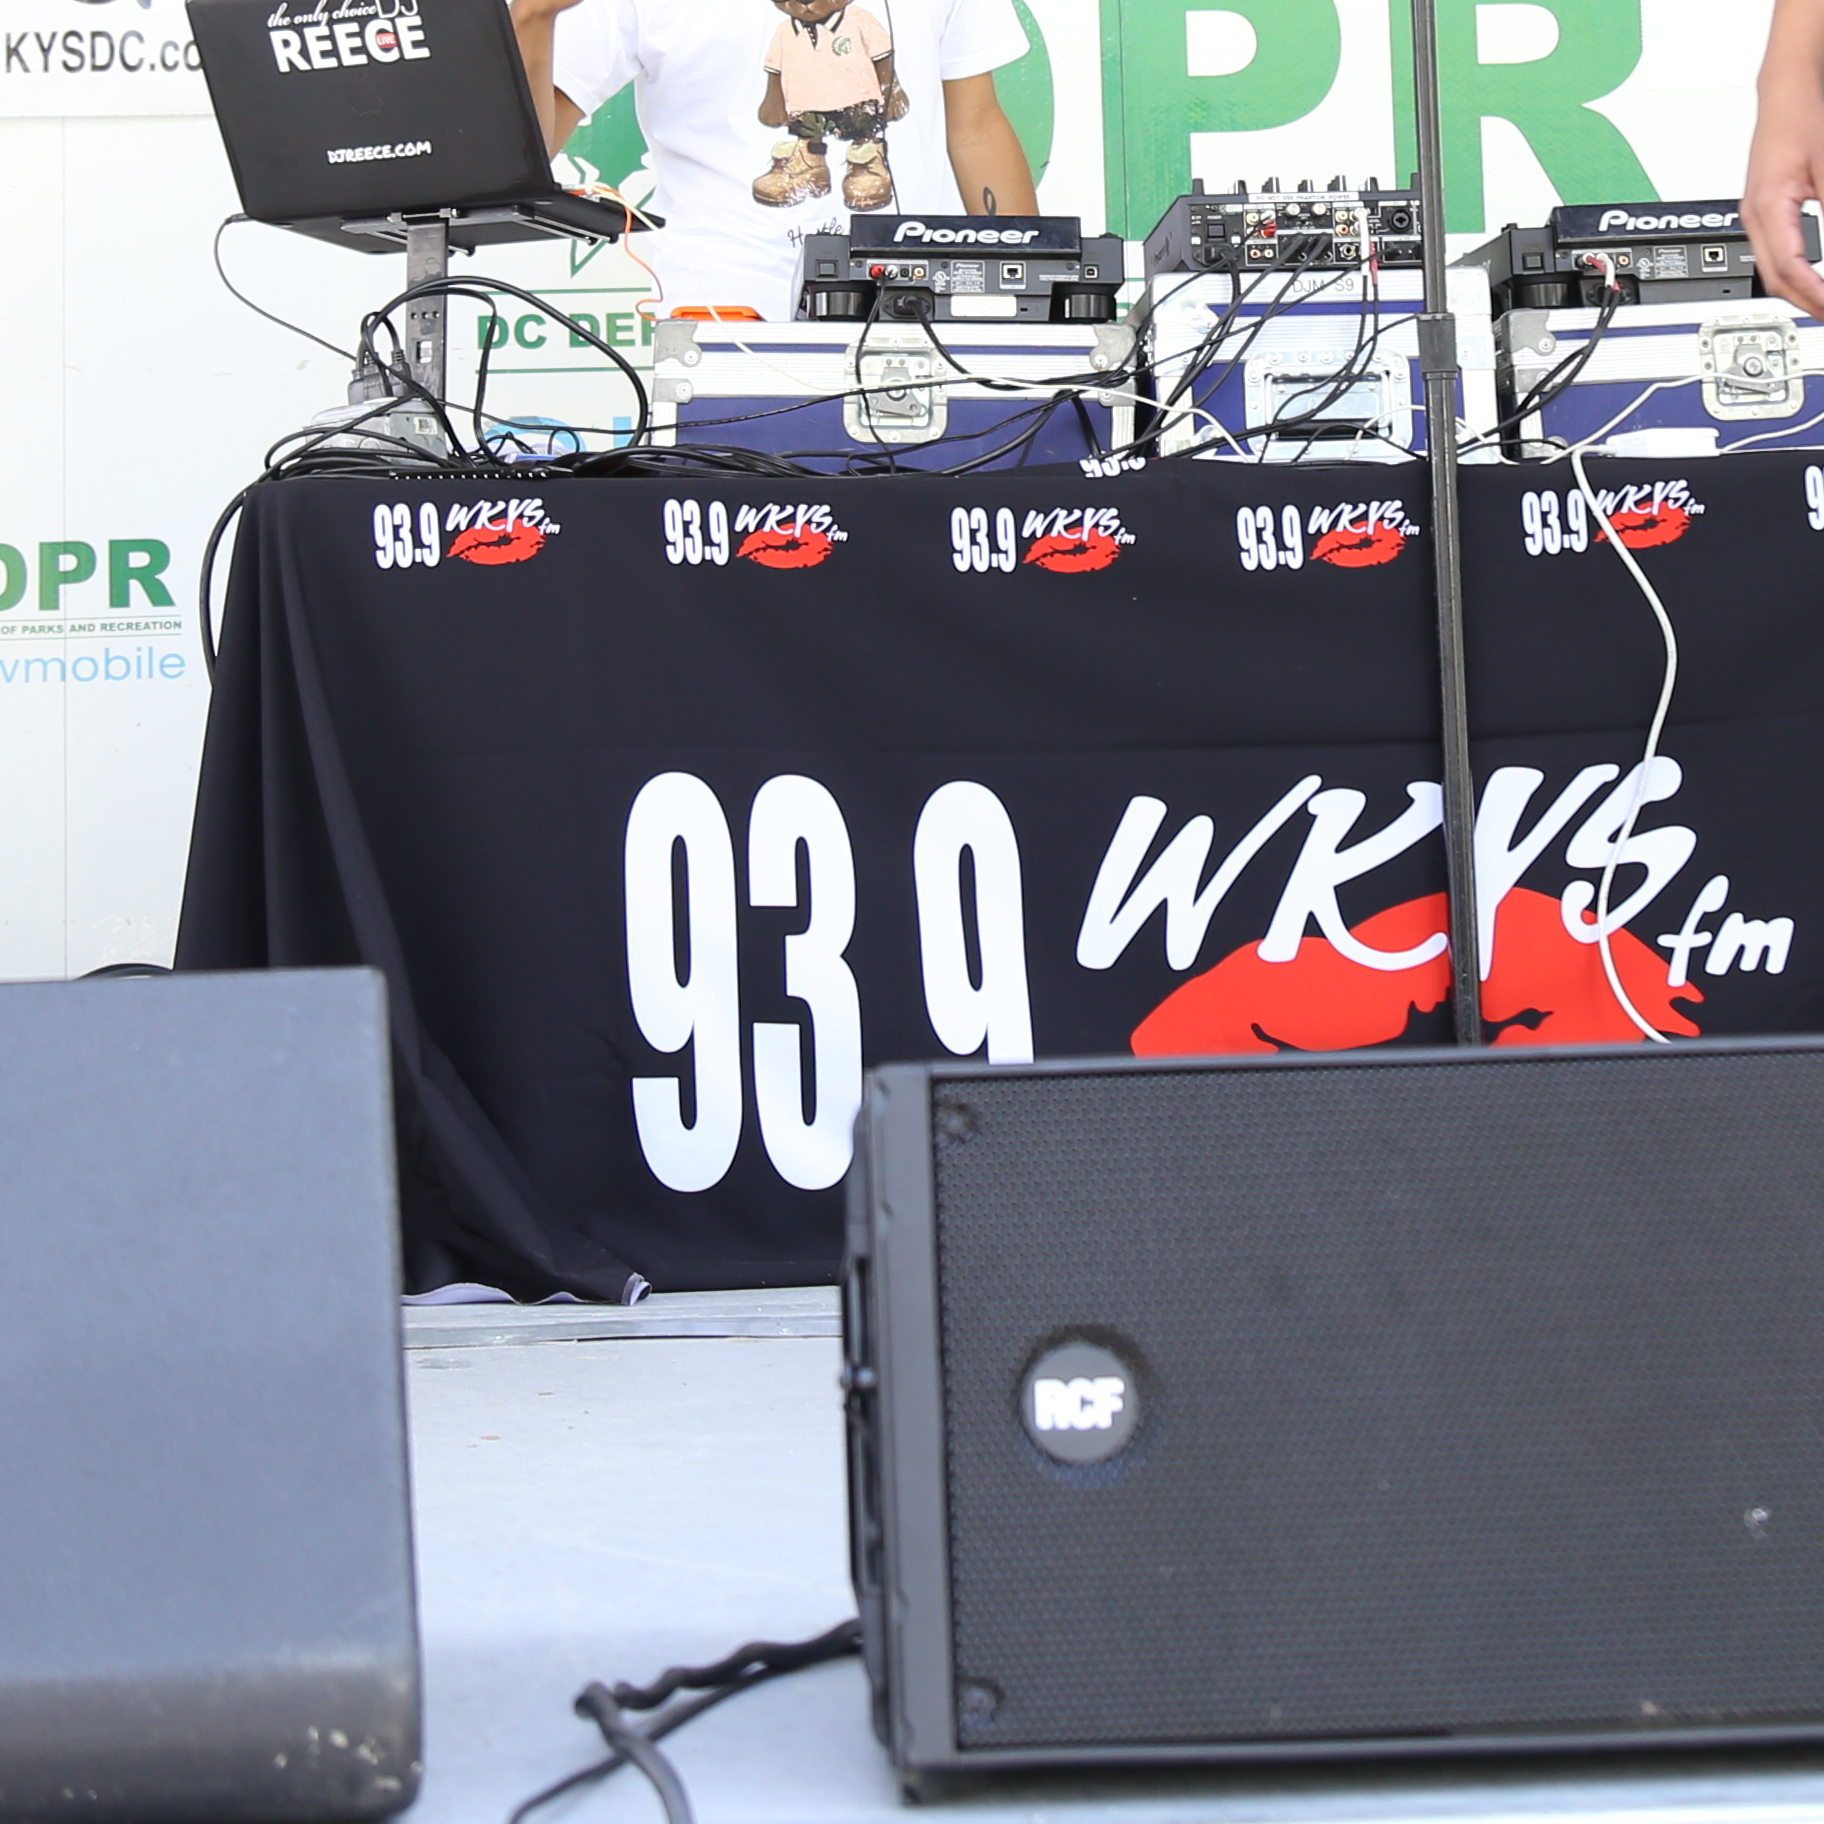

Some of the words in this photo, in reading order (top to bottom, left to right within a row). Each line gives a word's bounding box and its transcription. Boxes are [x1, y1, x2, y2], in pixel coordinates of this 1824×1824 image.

[267, 2, 292, 28] the
[4, 30, 204, 74] KYSDC.co
[269, 15, 431, 73] REECE
[376, 33, 397, 47] LIVE
[327, 141, 432, 164] DJREECE.COM
[893, 221, 1039, 244] Pioneer
[1598, 209, 1739, 232] Pioneer
[477, 313, 547, 349] DC
[373, 501, 442, 569] 93.9
[444, 497, 544, 533] WKYS
[538, 518, 561, 536] fm
[663, 498, 730, 566] 93.9
[734, 502, 832, 537] WKYS
[826, 523, 848, 542] fm
[950, 506, 1017, 574] 93.9
[1021, 506, 1121, 543] WKYS
[1113, 528, 1137, 546] fm
[1236, 504, 1305, 572] 93.9
[1306, 500, 1407, 537] WKYS
[1398, 517, 1421, 537] fm
[1521, 488, 1590, 557] 93.9
[1595, 479, 1693, 516] WKYS
[1683, 497, 1706, 517] fm
[1, 625, 19, 635] OF
[22, 624, 63, 635] PARKS
[69, 623, 96, 633] AND
[100, 621, 182, 632] RECREATION
[625, 772, 1035, 1192] 939
[1077, 757, 1697, 981] WKYS
[1657, 876, 1794, 986] fm
[1033, 1376, 1125, 1431] RCF
